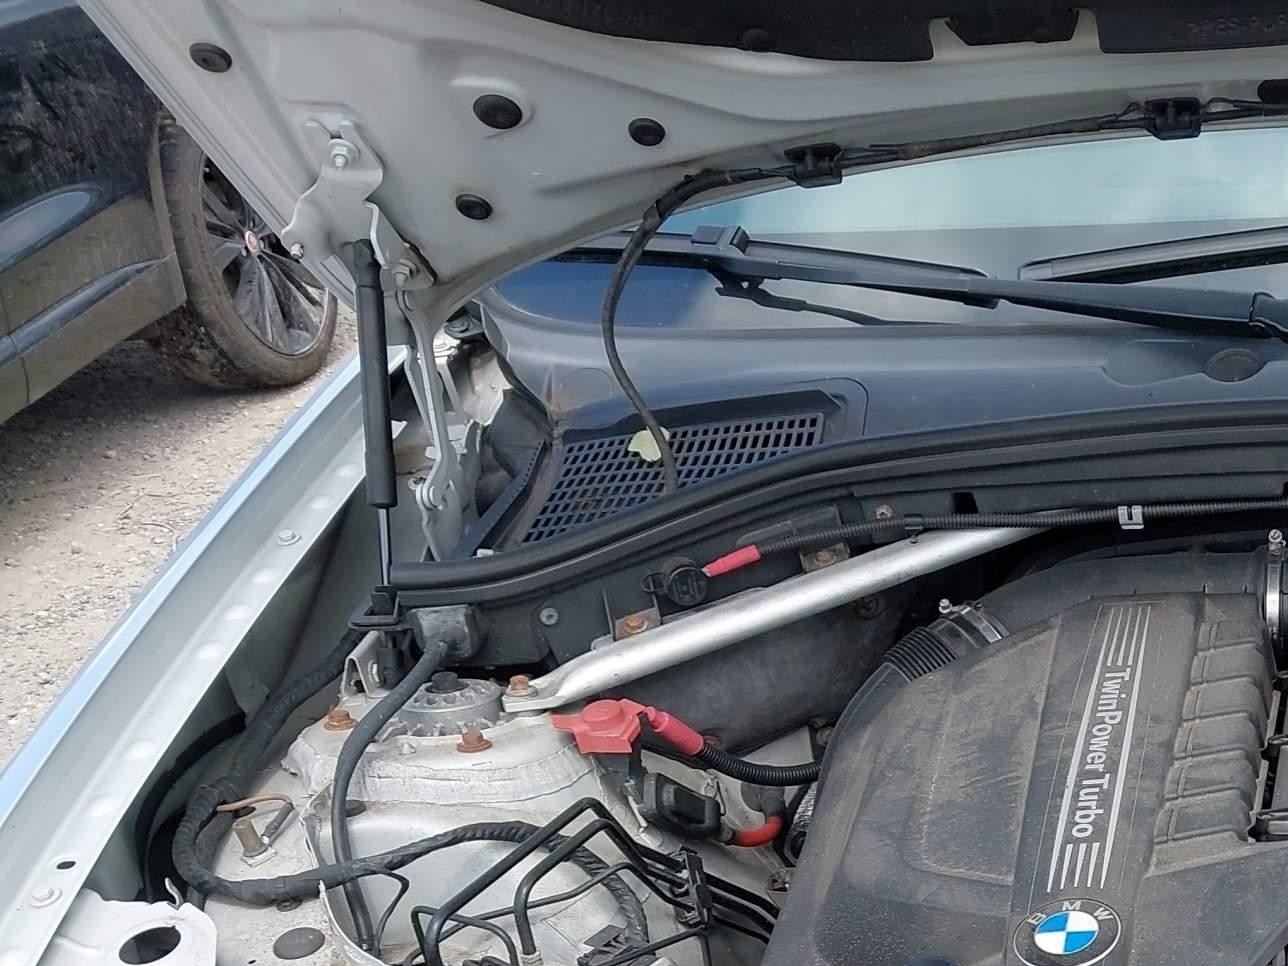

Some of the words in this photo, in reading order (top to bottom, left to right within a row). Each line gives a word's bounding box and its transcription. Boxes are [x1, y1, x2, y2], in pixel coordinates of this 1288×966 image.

[1086, 668, 1131, 771] TwinPower
[1071, 773, 1110, 838] Turbo
[1027, 900, 1114, 925] BMW
